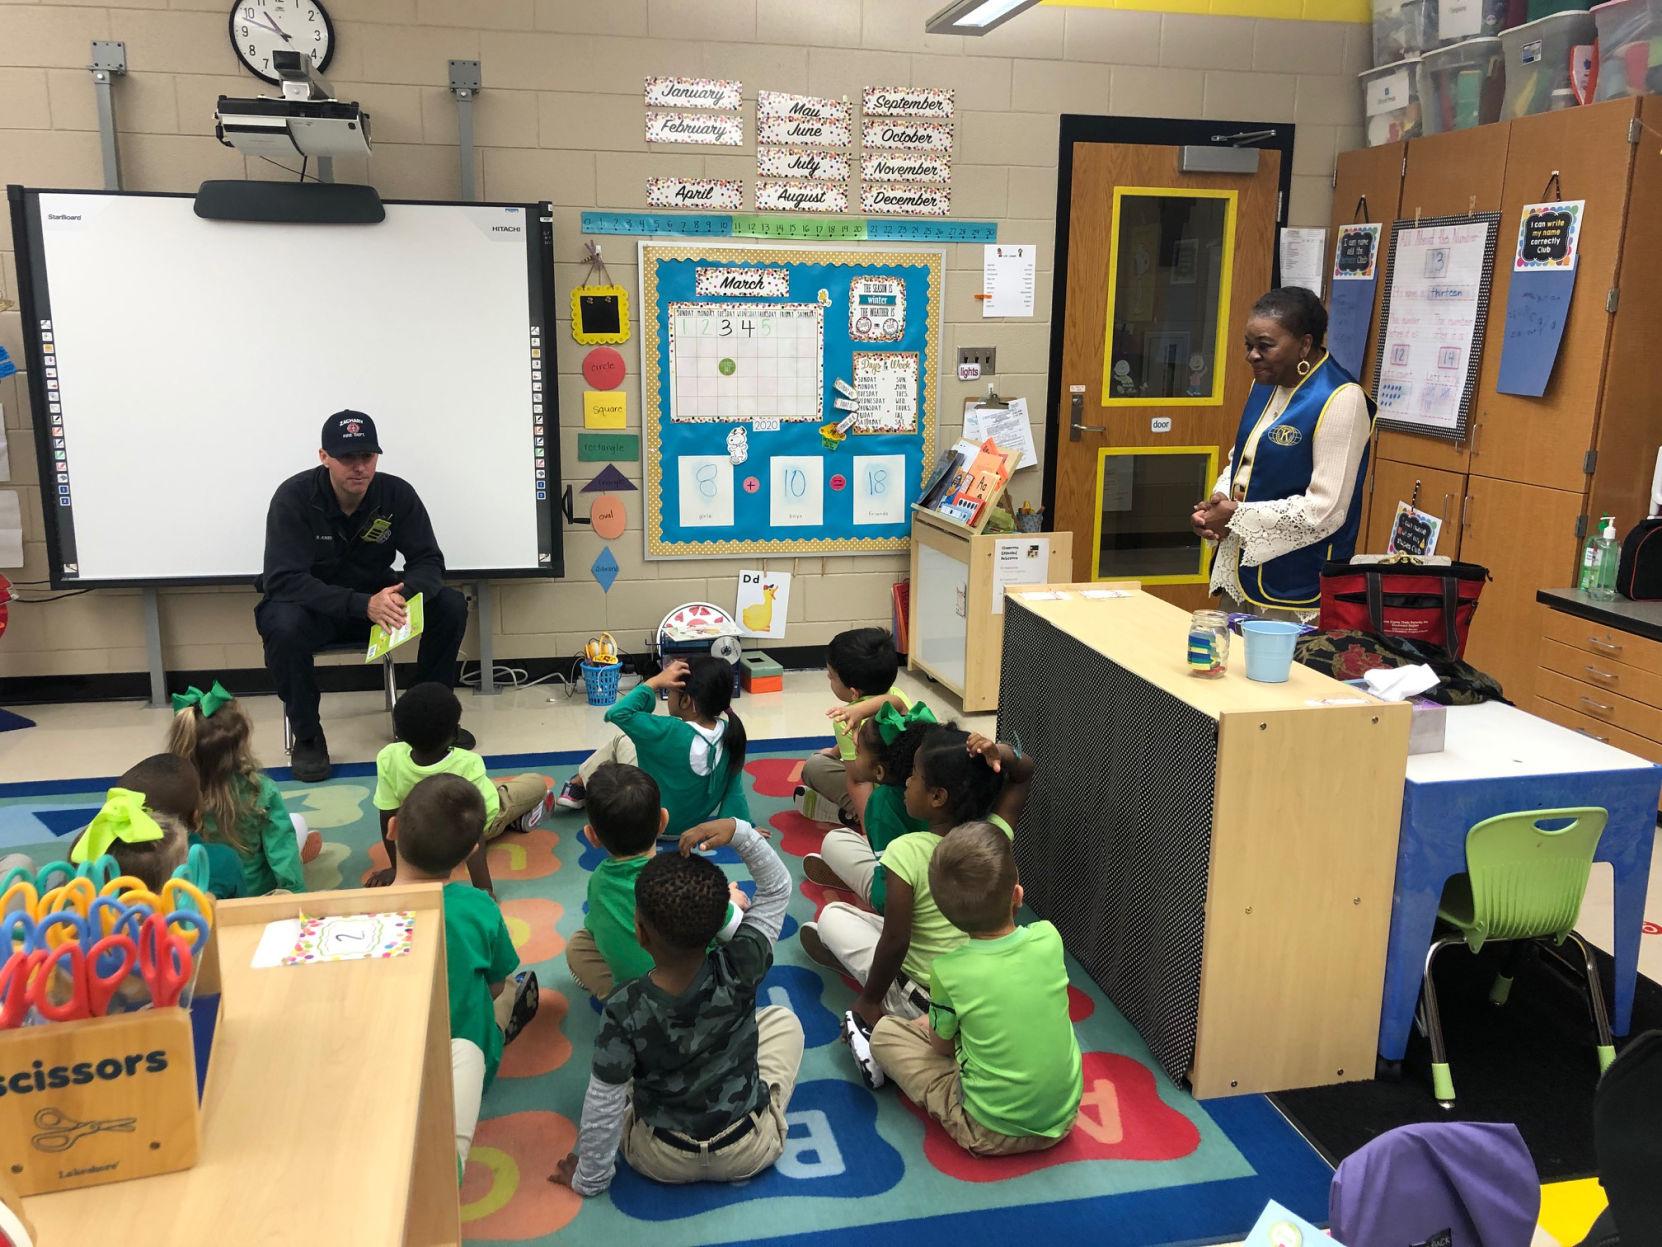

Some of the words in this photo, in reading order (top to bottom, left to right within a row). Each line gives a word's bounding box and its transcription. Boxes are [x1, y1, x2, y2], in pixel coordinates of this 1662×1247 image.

[244, 8, 255, 19] 10
[308, 10, 315, 21] 2
[241, 26, 248, 37] 9
[314, 30, 321, 41] 3
[249, 44, 256, 56] 8
[311, 48, 317, 59] 4
[262, 58, 269, 69] 7
[661, 84, 725, 106] January
[874, 94, 944, 112] September
[660, 119, 727, 141] February
[787, 123, 822, 136] June
[881, 128, 933, 144] October
[788, 155, 821, 176] July
[874, 161, 939, 176] November
[675, 185, 713, 202] April
[777, 188, 827, 208] August
[873, 191, 938, 207] December
[790, 224, 796, 232] 15
[802, 224, 810, 232] 16
[816, 225, 824, 233] 17
[828, 225, 836, 233] 18
[1547, 219, 1565, 227] write
[1530, 237, 1560, 246] correctly
[1536, 246, 1552, 254] Club
[720, 276, 765, 290] March
[872, 284, 887, 293] SEASON
[888, 284, 892, 293] IS
[868, 296, 888, 304] winter
[890, 308, 895, 317] IS
[719, 319, 732, 336] 3
[742, 320, 755, 338] 4
[762, 318, 770, 336] 5
[862, 360, 882, 375] Days
[890, 360, 910, 369] Week
[960, 366, 978, 378] lights
[755, 420, 778, 430] 2020
[1152, 420, 1170, 428] door
[696, 464, 718, 498] 8
[784, 469, 806, 498] 10
[868, 469, 888, 496] 18
[598, 509, 614, 520] oval
[1075, 1078, 1123, 1145] A
[774, 1109, 846, 1179] B
[58, 1161, 120, 1178] Lakeshore
